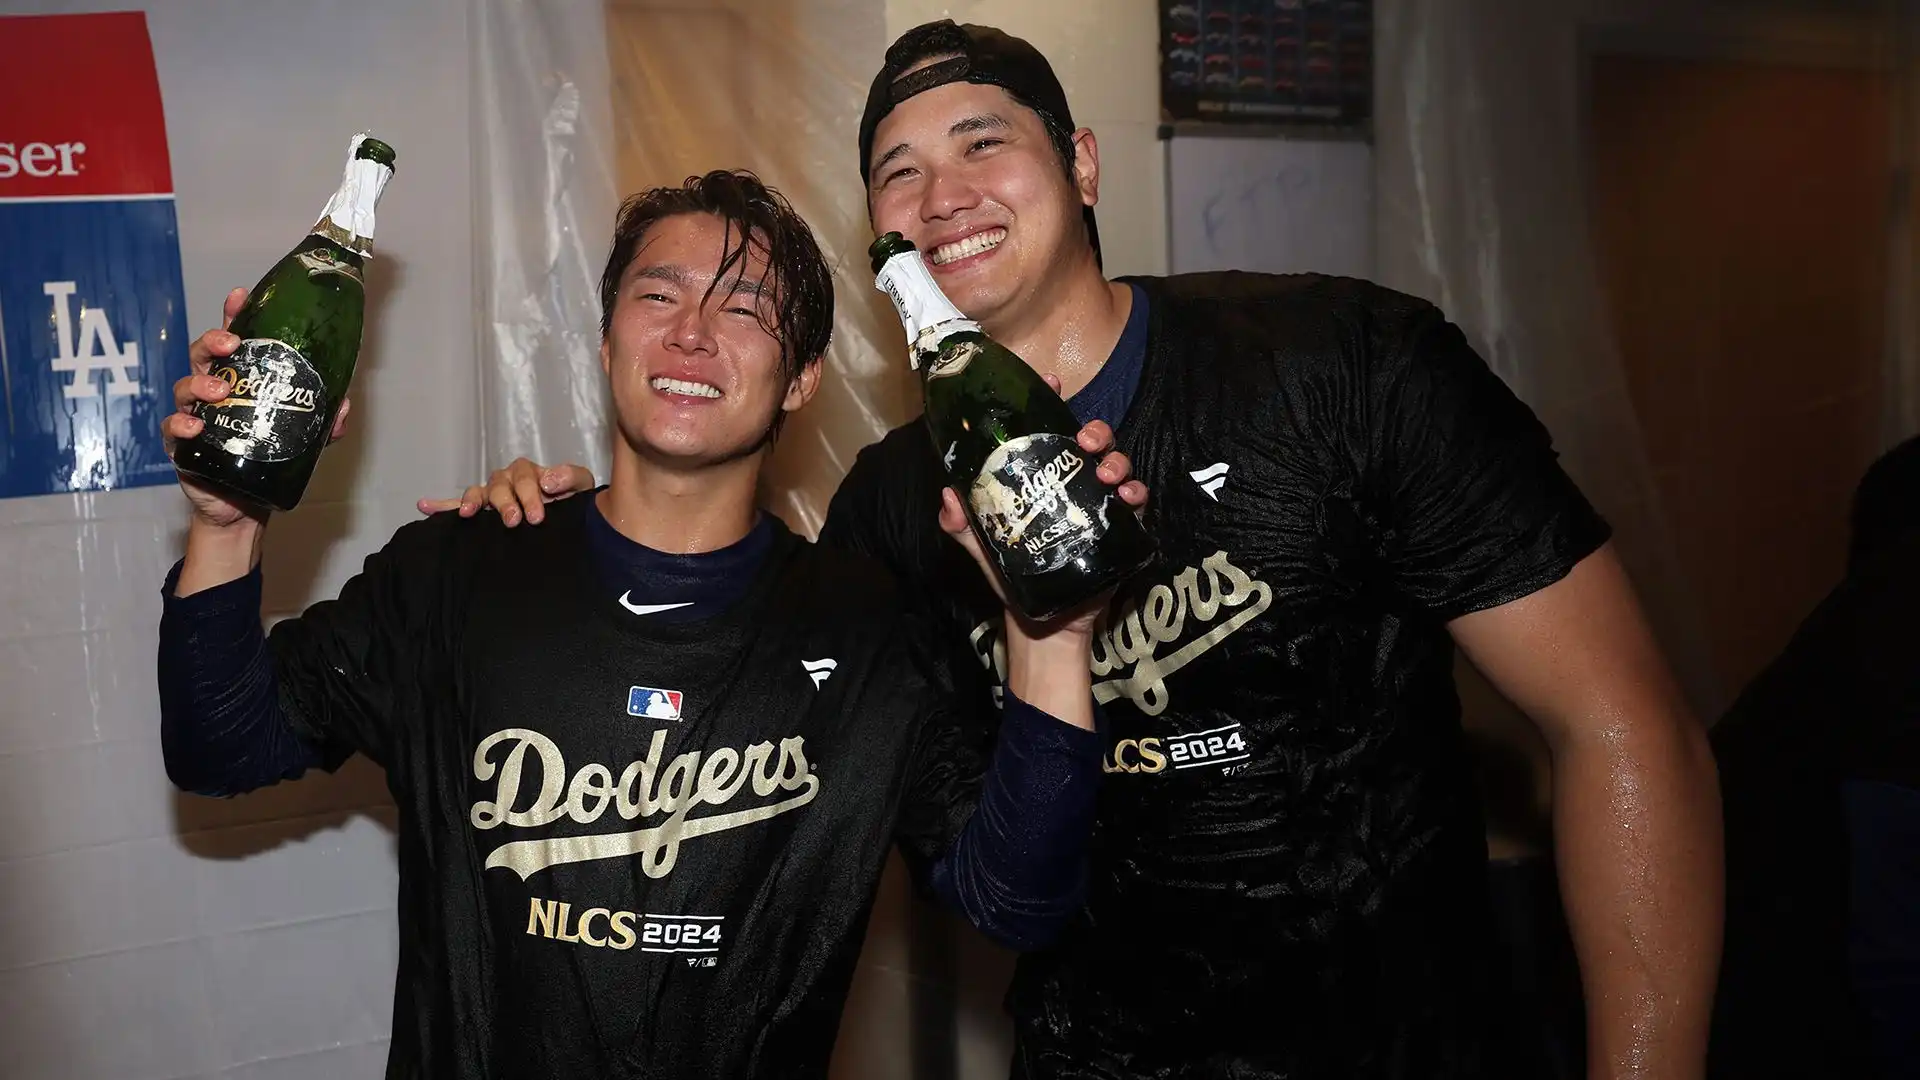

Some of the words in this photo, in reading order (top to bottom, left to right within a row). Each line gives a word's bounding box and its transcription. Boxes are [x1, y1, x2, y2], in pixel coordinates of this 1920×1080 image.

[43, 281, 140, 399] LA
[1169, 732, 1247, 762] 2024
[470, 728, 820, 882] Dodgers
[526, 897, 637, 950] NLCS
[642, 922, 722, 944] 2024
